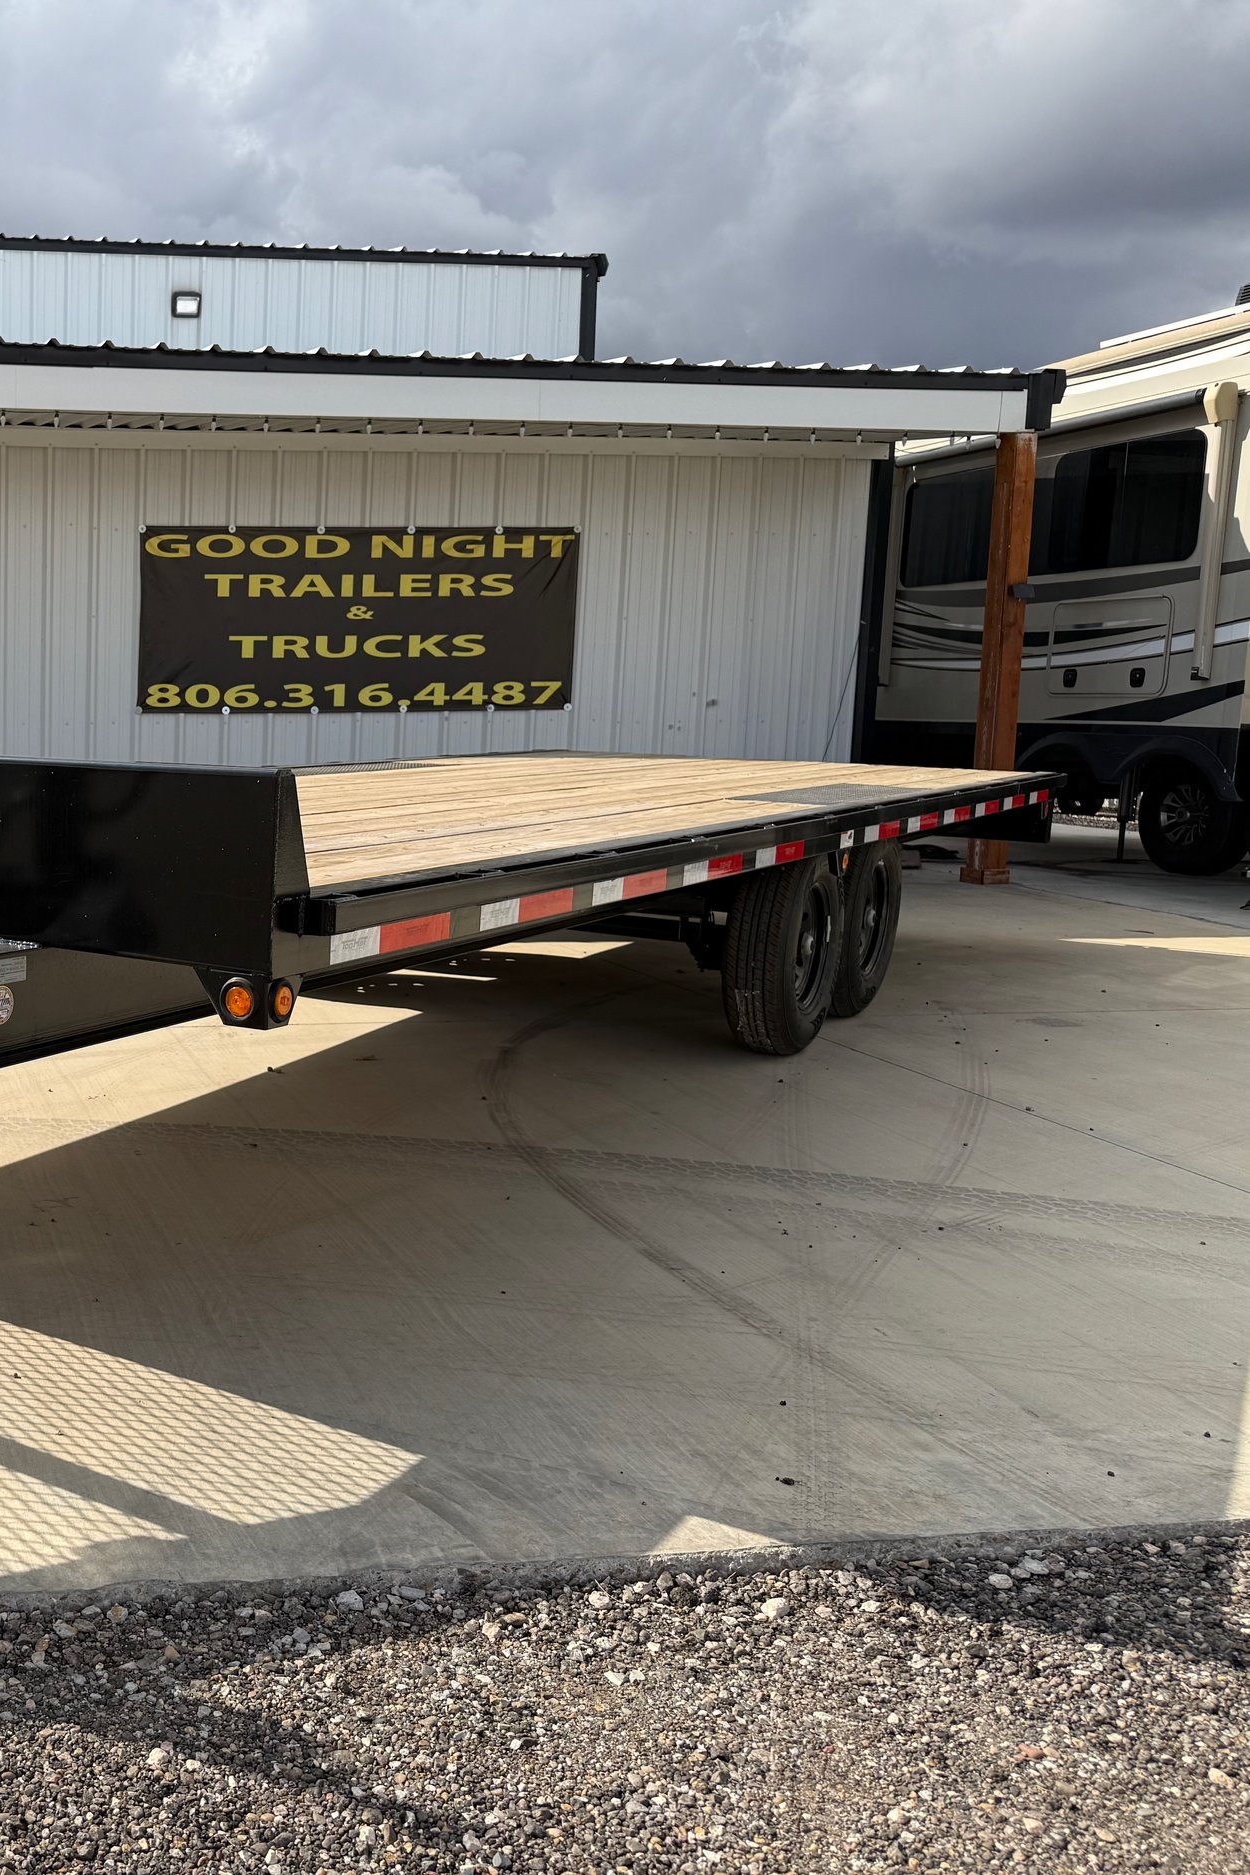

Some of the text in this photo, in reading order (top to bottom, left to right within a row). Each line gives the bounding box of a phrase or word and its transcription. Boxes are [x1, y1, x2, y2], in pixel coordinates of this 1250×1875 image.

[145, 534, 575, 559] GOOD NIGHT
[204, 573, 515, 598] TRAILERS
[346, 605, 374, 620] &
[229, 634, 486, 659] TRUCKS
[145, 680, 562, 708] 806.316.4487
